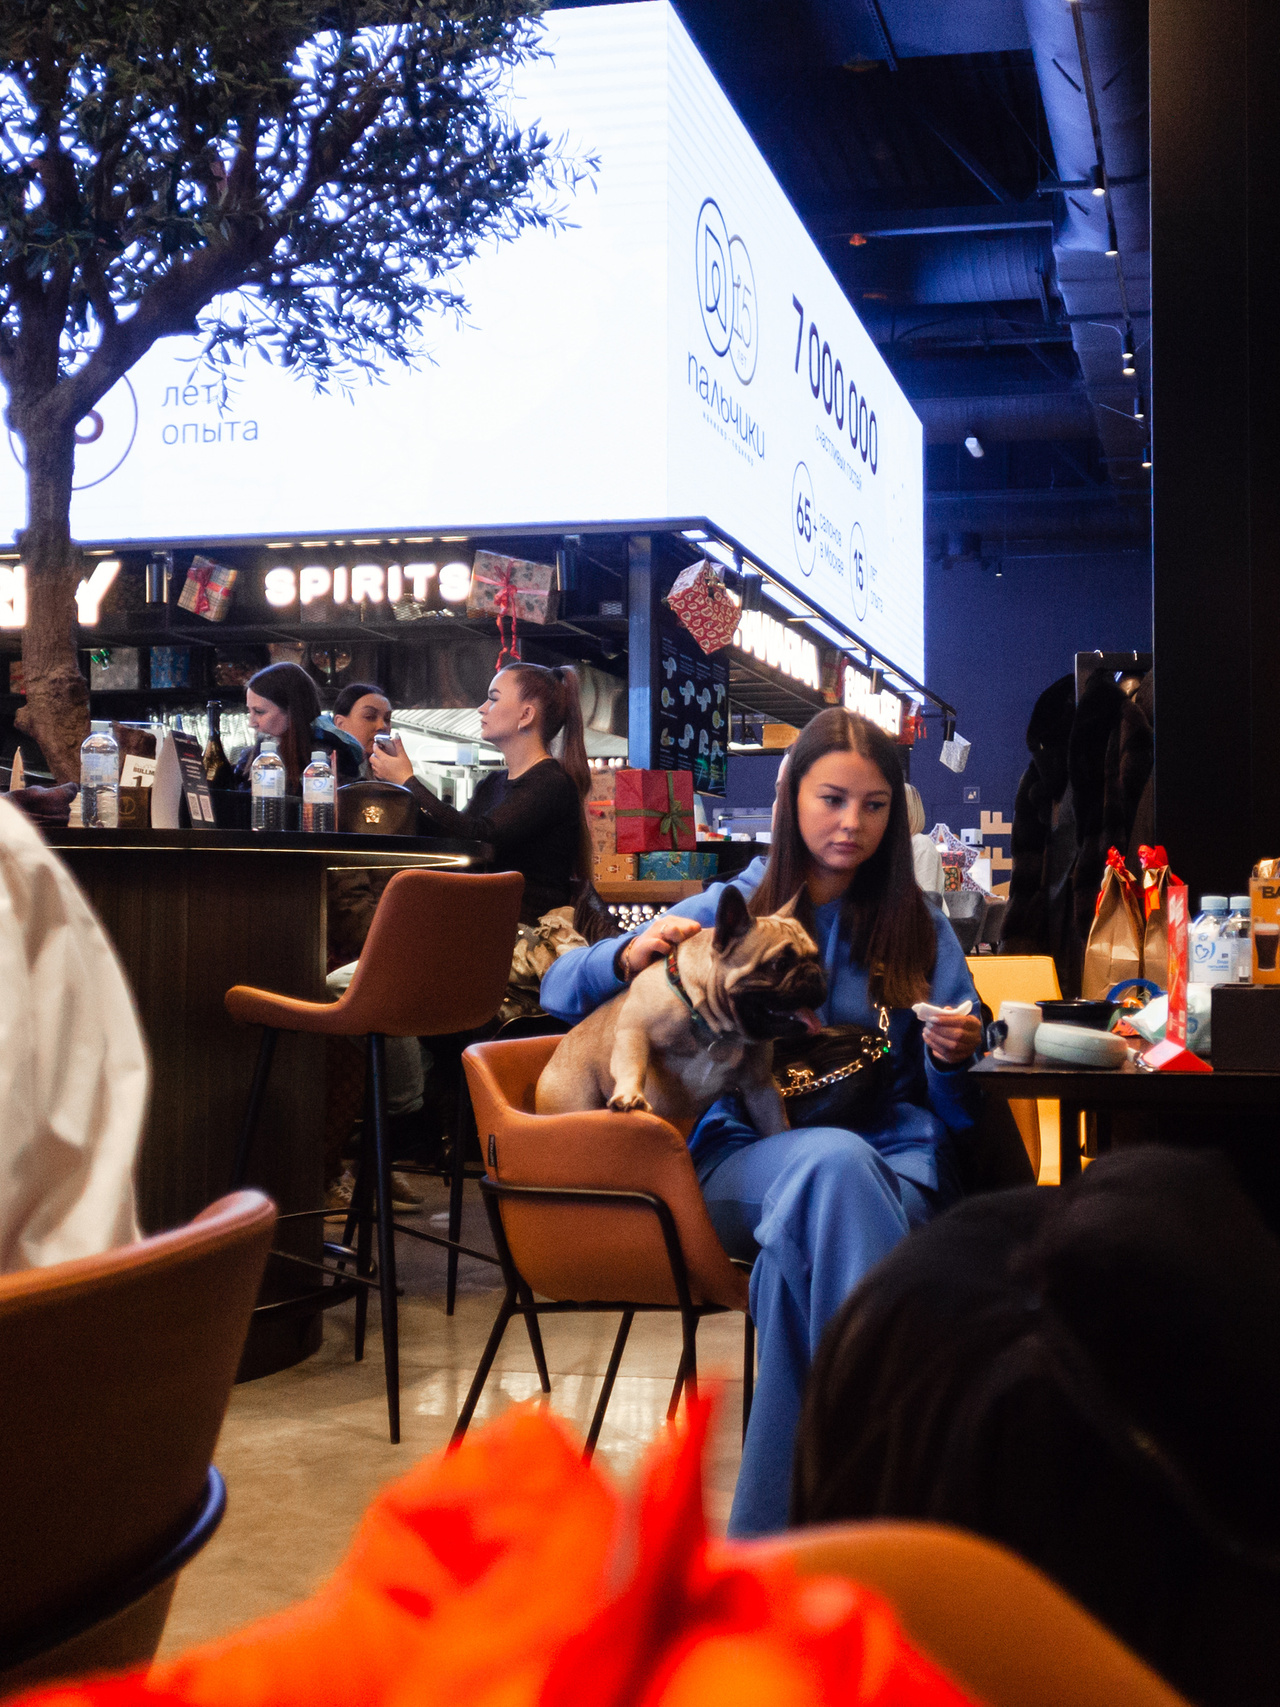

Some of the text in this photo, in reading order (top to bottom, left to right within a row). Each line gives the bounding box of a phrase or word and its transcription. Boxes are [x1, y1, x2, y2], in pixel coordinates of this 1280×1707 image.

[161, 383, 219, 407] лет
[792, 293, 878, 475] 7 000 000
[162, 420, 259, 445] опыта
[264, 561, 472, 606] SPIRITS
[853, 548, 865, 592] 15
